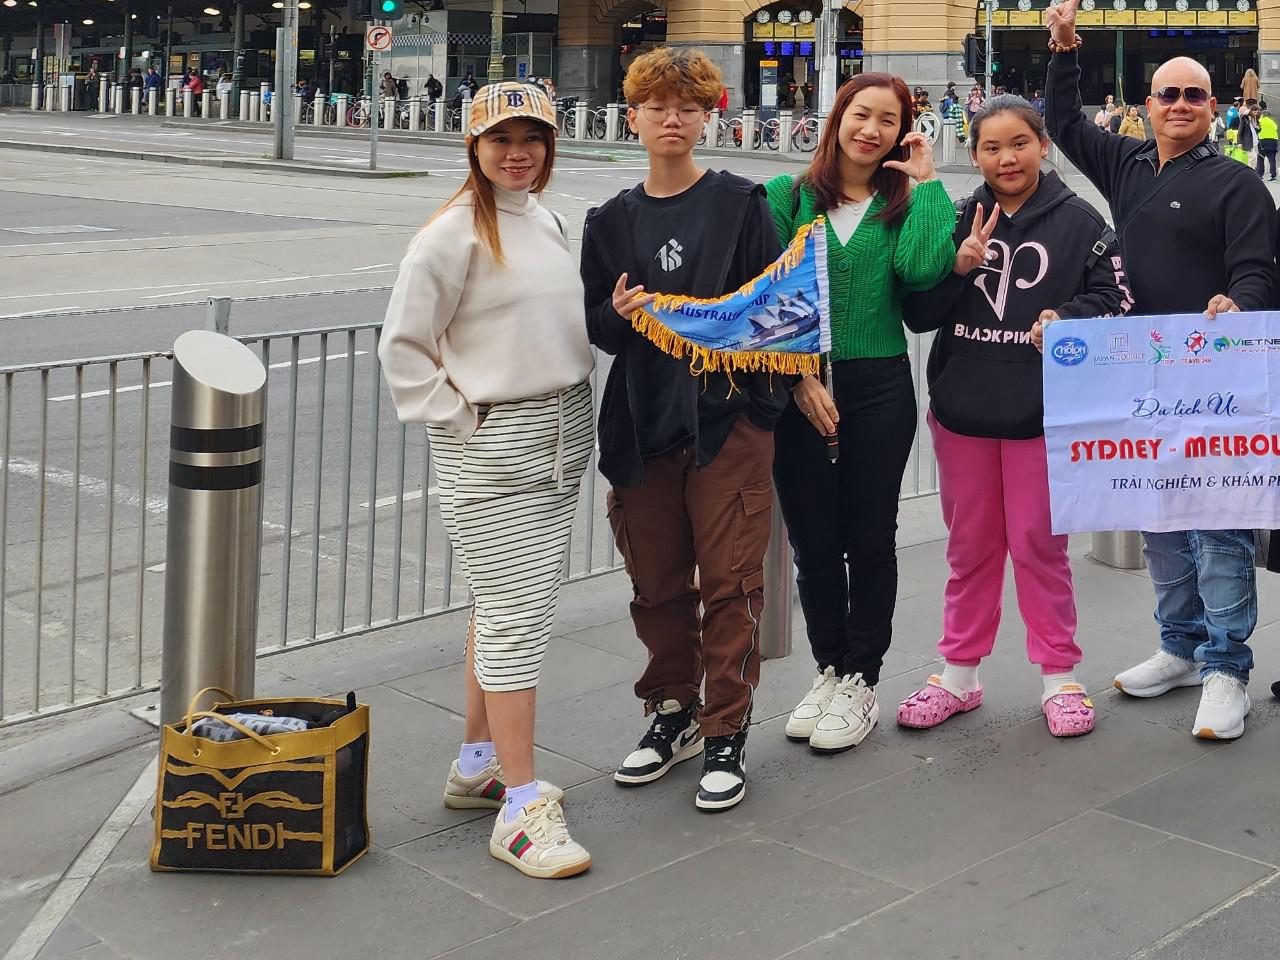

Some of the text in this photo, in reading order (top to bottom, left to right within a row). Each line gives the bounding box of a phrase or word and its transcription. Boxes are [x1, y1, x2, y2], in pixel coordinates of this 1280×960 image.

[954, 323, 1034, 345] BLACKPIN
[1132, 397, 1168, 419] Du
[1173, 398, 1203, 418] lịch
[1071, 438, 1163, 462] SYDNEY
[1146, 474, 1202, 491] NGHIỆM
[1206, 475, 1218, 488] &
[1221, 472, 1264, 487] KHÁM
[186, 822, 285, 850] FENDI
